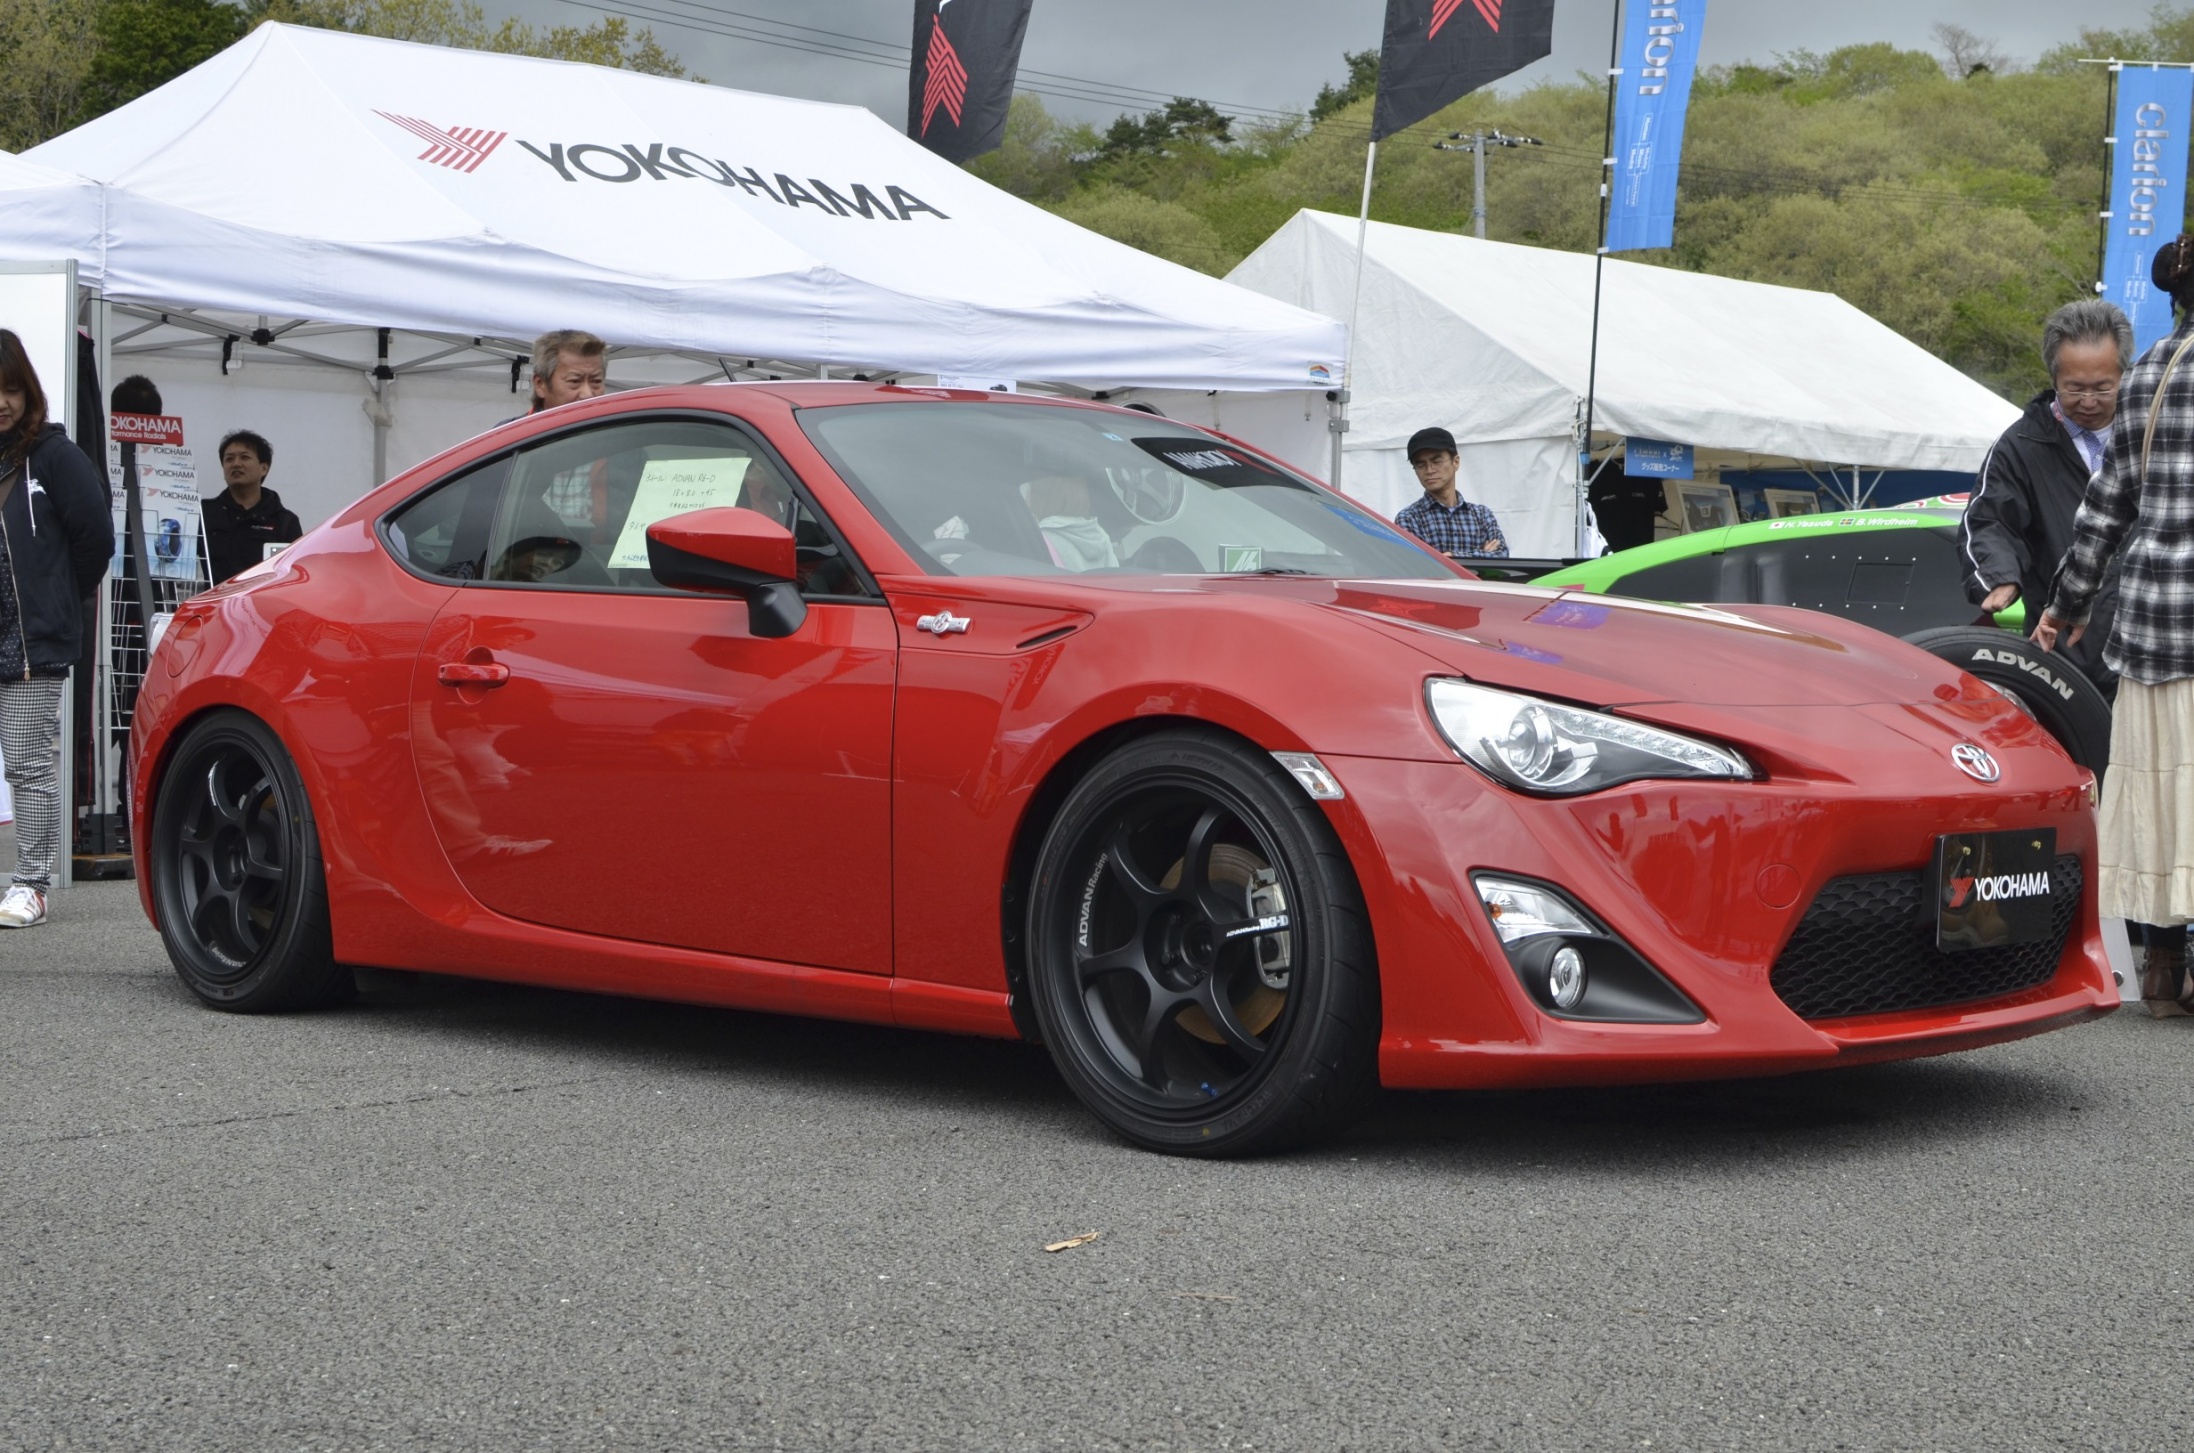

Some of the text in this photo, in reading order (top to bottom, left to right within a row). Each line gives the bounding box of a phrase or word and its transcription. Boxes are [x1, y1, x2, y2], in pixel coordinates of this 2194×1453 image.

[514, 139, 952, 222] YOKOHAMA
[2128, 102, 2169, 236] clarion
[111, 415, 182, 434] OKOHAMA
[111, 430, 167, 440] formance Radials
[152, 446, 193, 457] YOKOHAMA
[154, 468, 195, 479] YOKOHAMA
[159, 490, 200, 503] YOKOHAMA
[1971, 648, 2075, 701] ADVAN
[1974, 871, 2050, 902] YOKOHAMA
[1079, 887, 1094, 947] ADVAN
